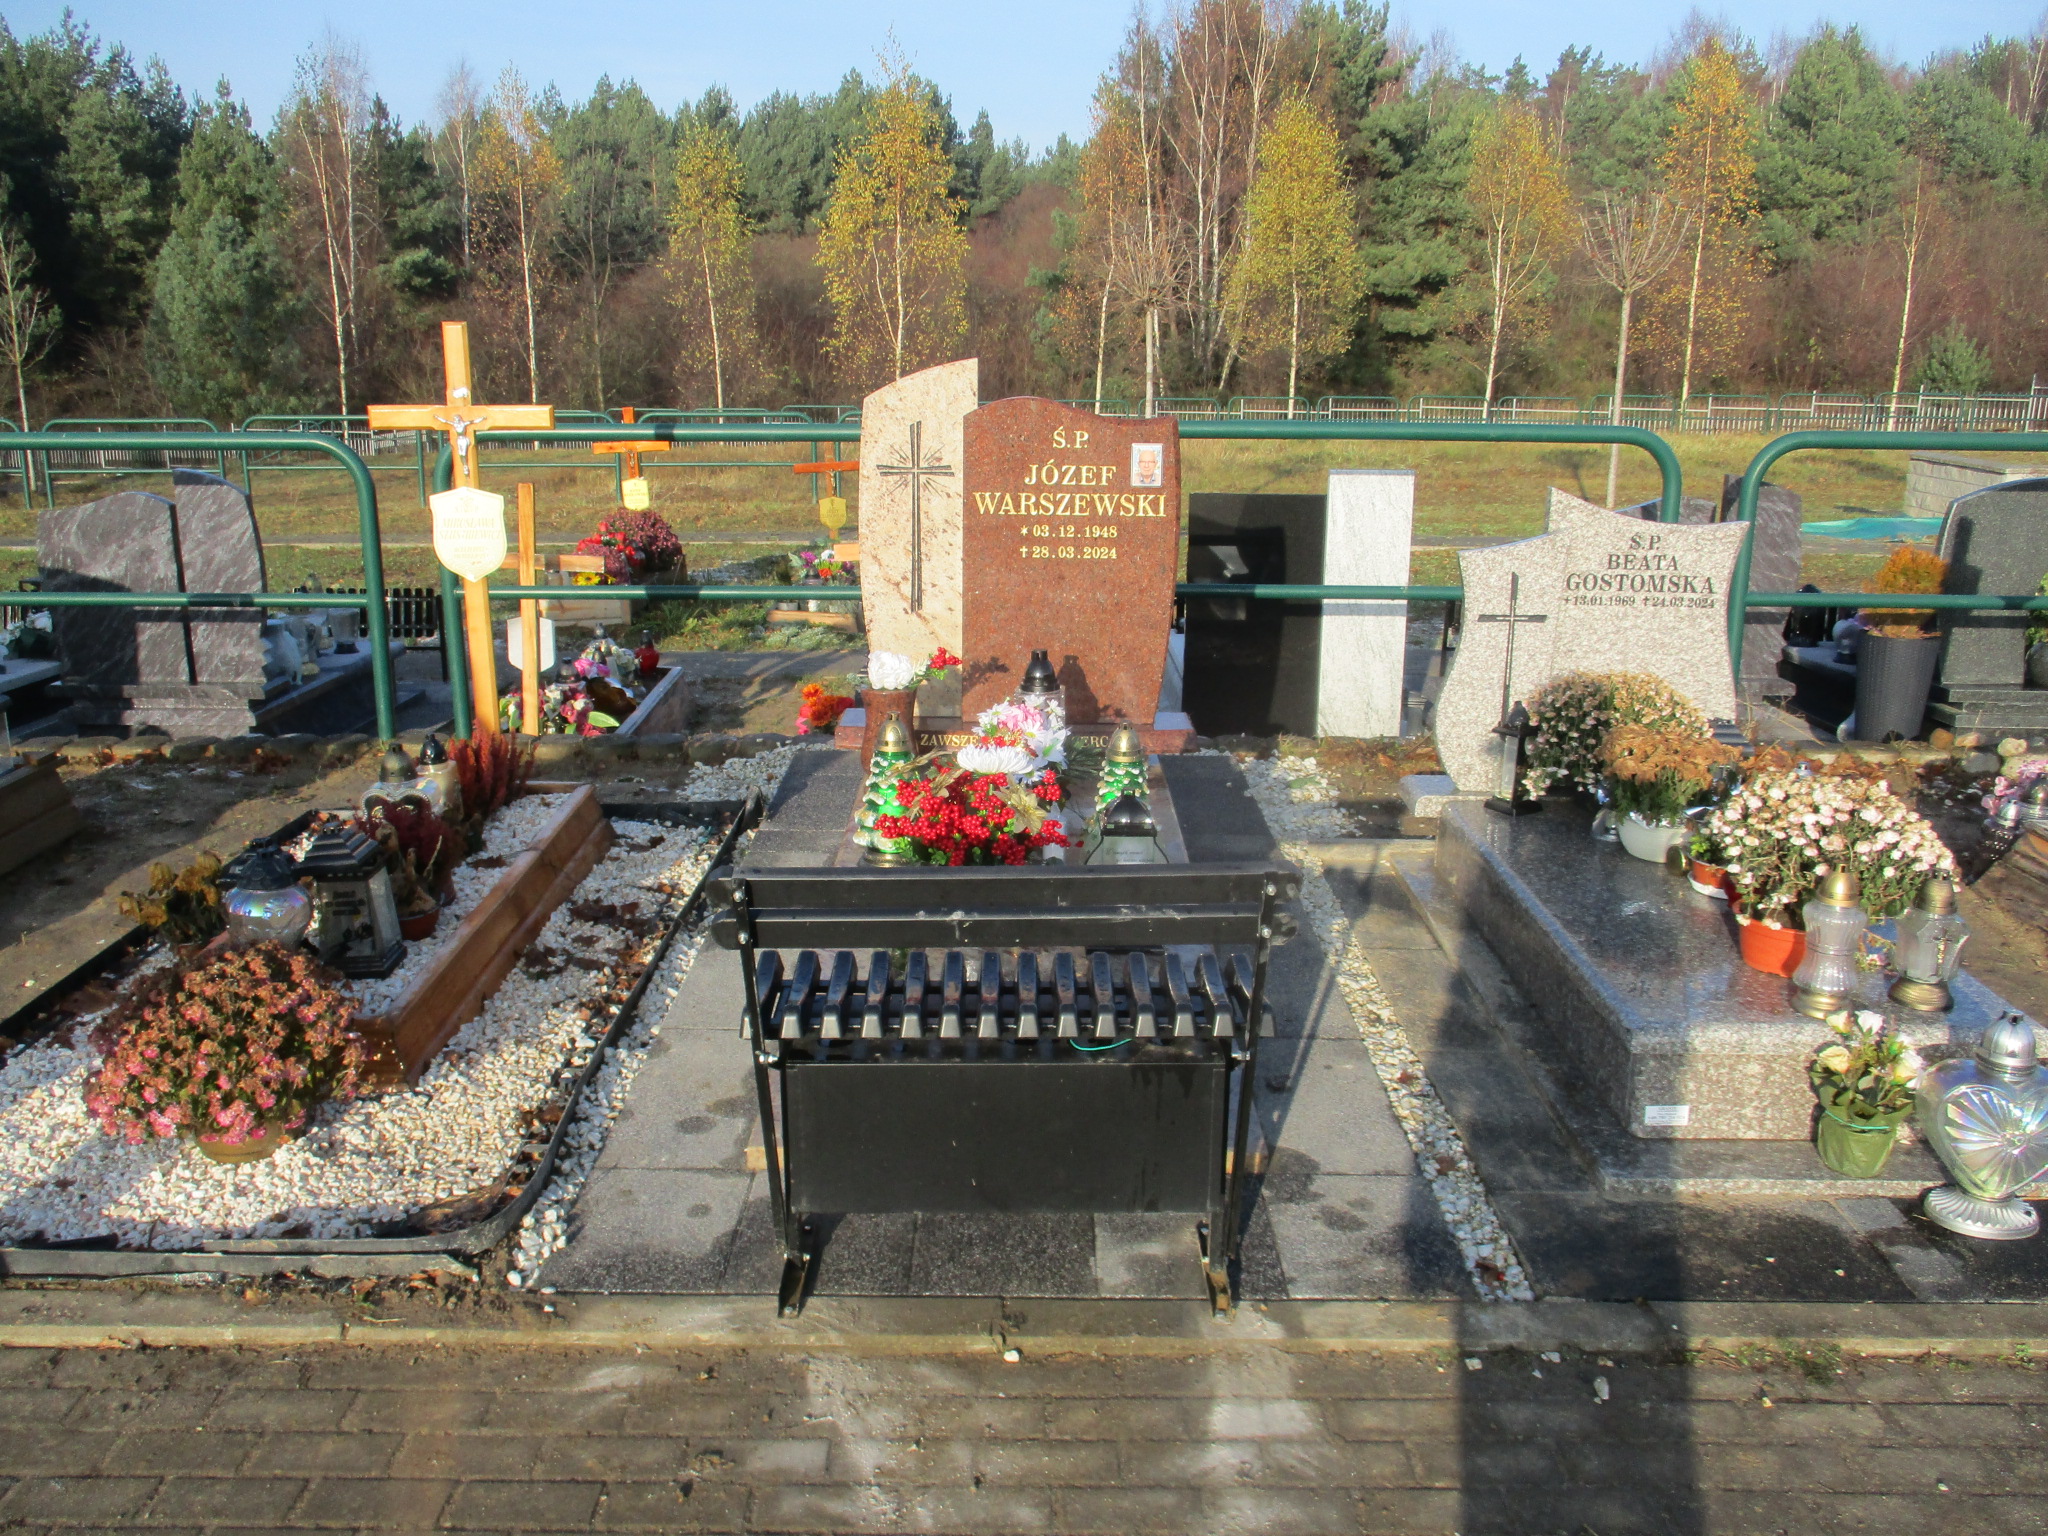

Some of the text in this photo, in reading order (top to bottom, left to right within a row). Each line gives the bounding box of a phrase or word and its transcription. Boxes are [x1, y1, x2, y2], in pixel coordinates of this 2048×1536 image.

[1024, 459, 1117, 486] JÓZEF
[973, 491, 1167, 517] WARSZEWSKI
[1607, 554, 1679, 571] BEATA
[1566, 573, 1716, 594] GOSTOMSKA
[920, 733, 979, 747] ZAWSZE
